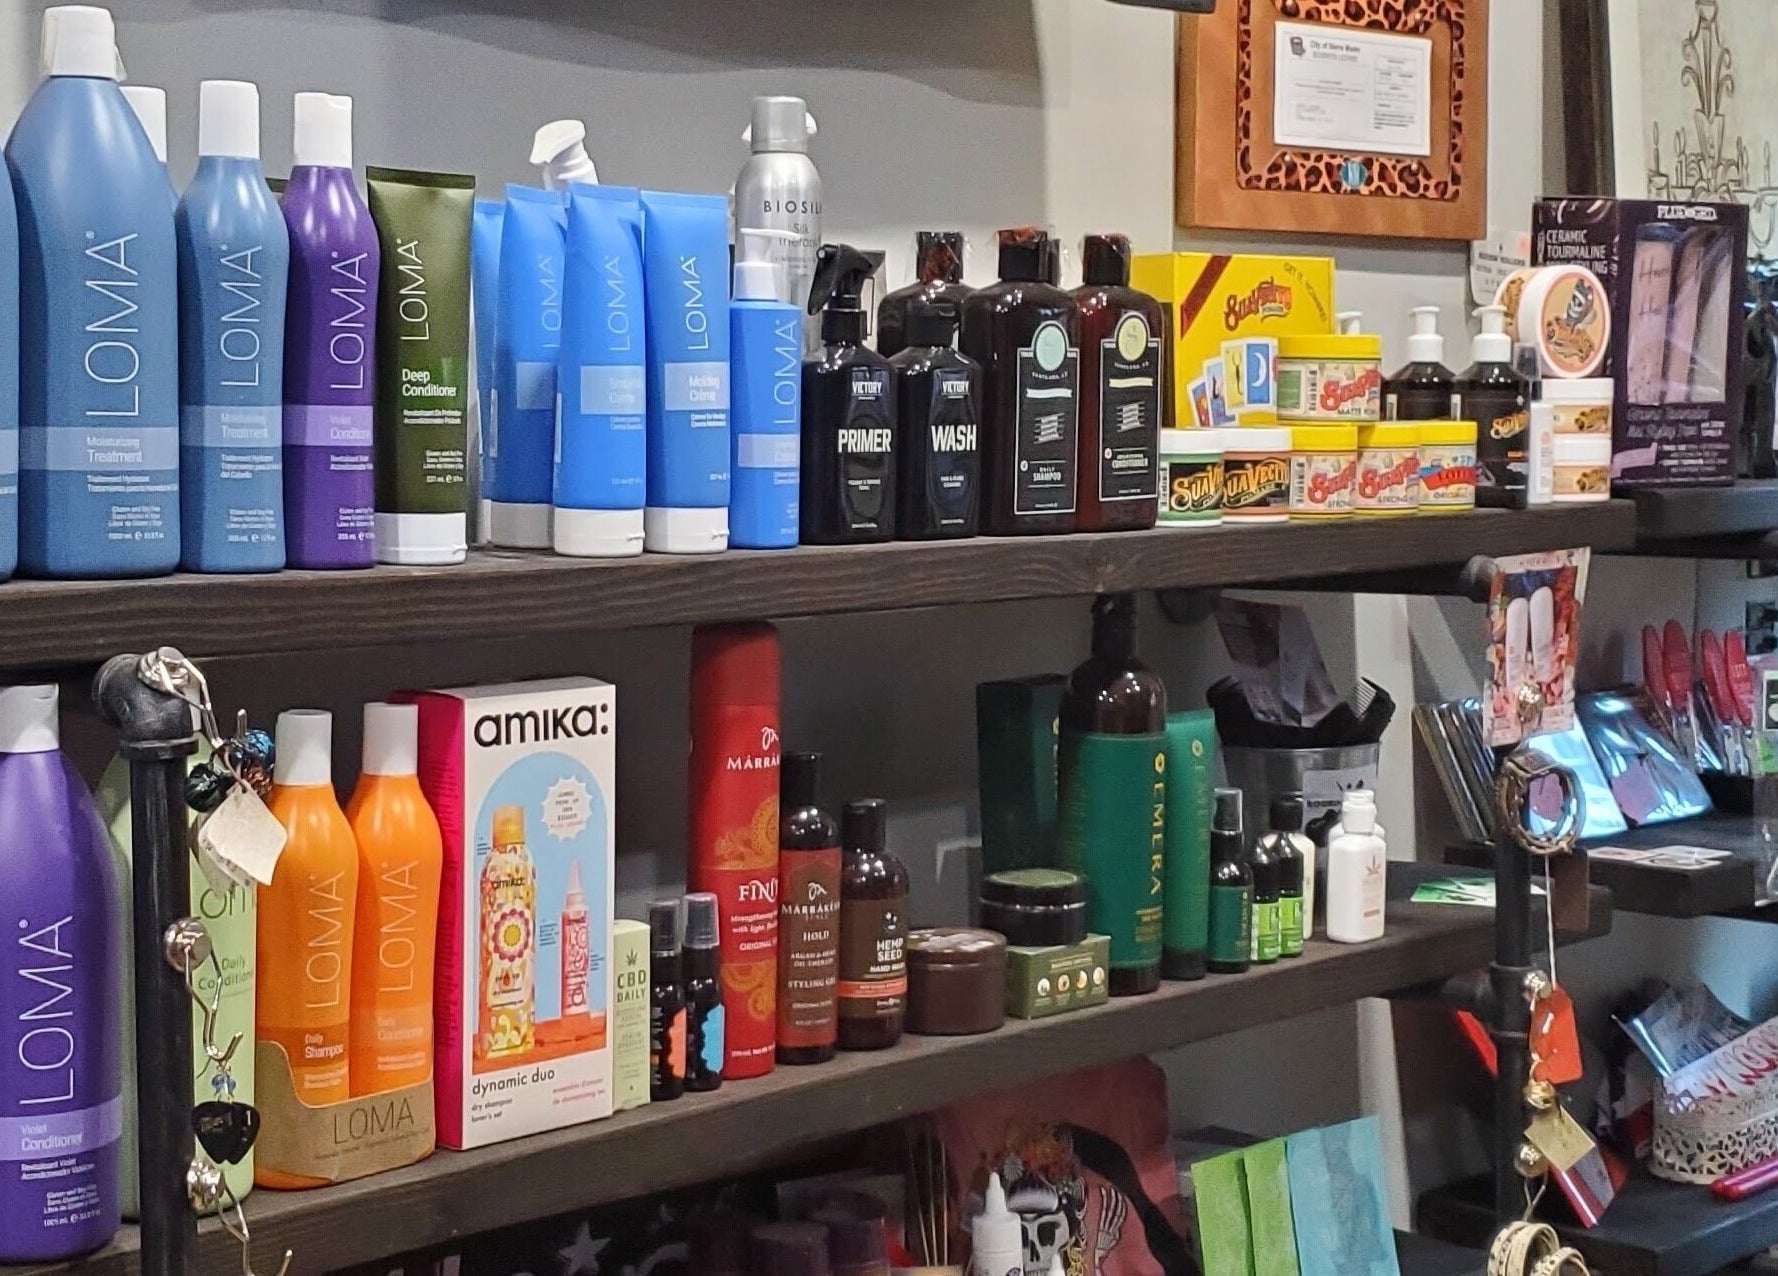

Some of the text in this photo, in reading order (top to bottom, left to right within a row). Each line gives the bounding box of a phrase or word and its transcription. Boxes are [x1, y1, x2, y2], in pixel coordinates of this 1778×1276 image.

[1546, 229, 1587, 244] CERAMIC
[1547, 245, 1607, 259] TOURMALINE
[397, 238, 430, 341] LOMA
[604, 254, 631, 351] LOMA
[680, 255, 709, 350] LOMA
[85, 231, 139, 416] LOMA
[220, 244, 263, 387] LOMA
[330, 251, 368, 389] LOMA
[402, 368, 431, 383] Deep
[773, 319, 799, 425] LOMA
[402, 383, 458, 398] Conditioner
[689, 375, 721, 389] Molding
[852, 381, 883, 394] VICTORY
[942, 380, 970, 393] VICTORY
[837, 428, 892, 453] PRIMER
[931, 424, 977, 451] WASH
[87, 449, 143, 464] Treatment
[474, 702, 609, 748] amika:
[378, 860, 420, 992] LOMA
[305, 870, 345, 1008] LOMA
[803, 930, 830, 942] HOLD
[877, 937, 904, 952] HEMP
[878, 949, 903, 962] SEED
[616, 969, 647, 989] CBD
[788, 979, 825, 990] STYLING
[616, 988, 646, 1003] DAILY
[19, 915, 74, 1105] LOMA
[304, 1033, 324, 1045] Daily
[304, 1043, 344, 1060] Shampoo
[472, 1067, 555, 1098] dynamic duo
[21, 1123, 47, 1135] Violet
[333, 1096, 415, 1145] LOMA
[21, 1132, 83, 1151] Conditioner
